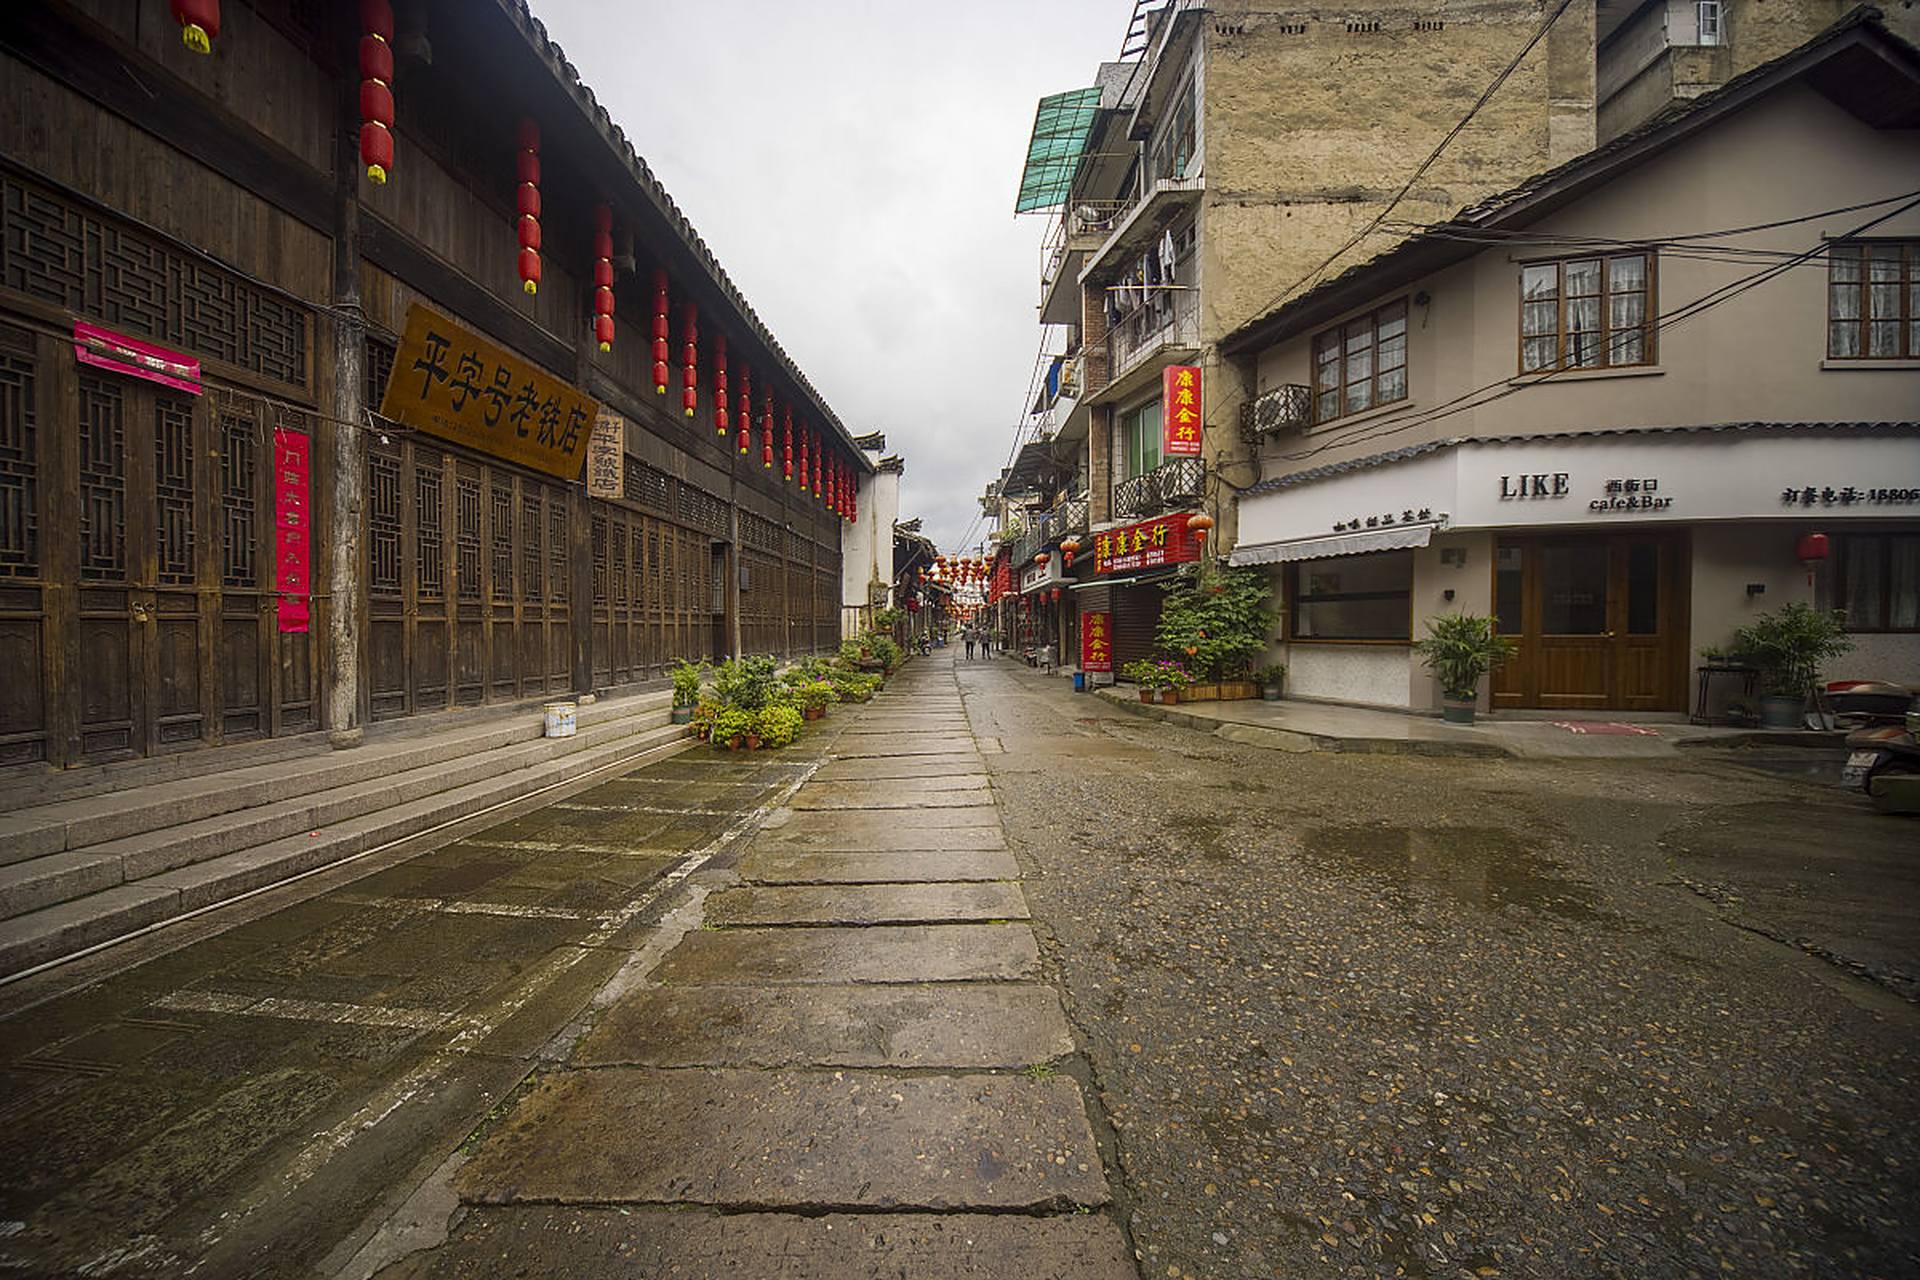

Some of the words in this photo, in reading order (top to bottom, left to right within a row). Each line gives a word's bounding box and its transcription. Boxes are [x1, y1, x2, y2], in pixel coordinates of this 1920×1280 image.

[1175, 369, 1198, 441] 康康金行
[1501, 473, 1569, 499] LIKE
[1589, 495, 1673, 511] cafe&Bar
